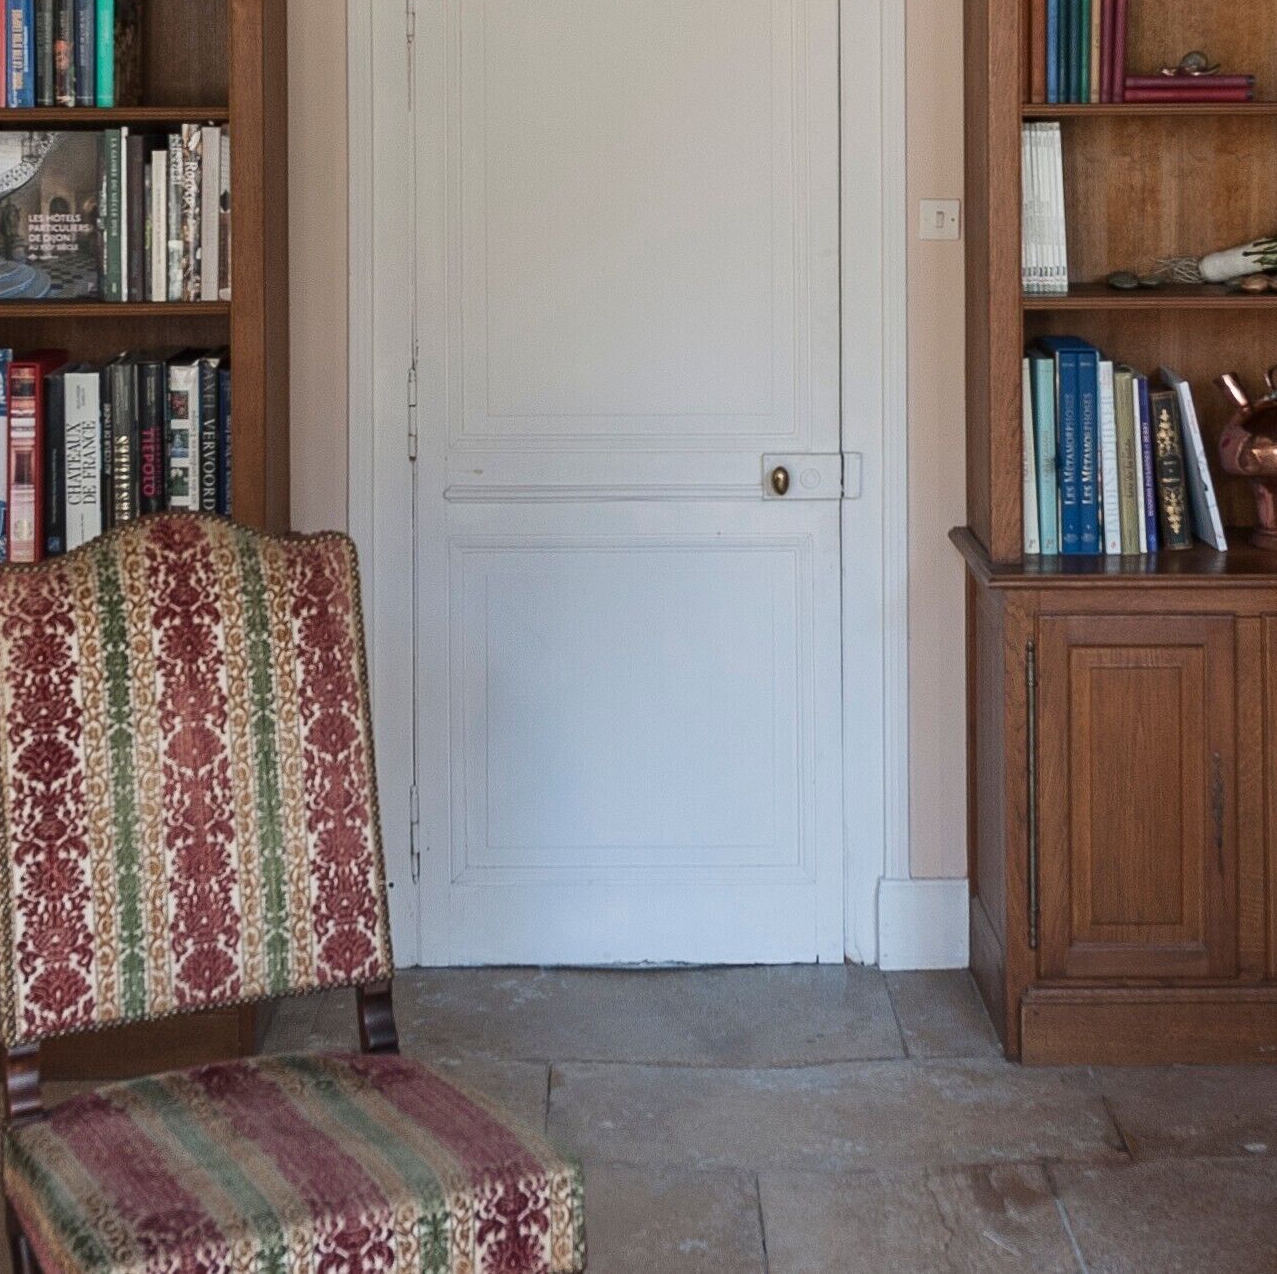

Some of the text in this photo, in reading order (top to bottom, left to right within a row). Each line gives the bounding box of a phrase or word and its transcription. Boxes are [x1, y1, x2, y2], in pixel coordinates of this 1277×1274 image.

[28, 214, 45, 223] LES
[28, 224, 91, 232] PARTICULIERS
[28, 234, 40, 243] DE
[66, 422, 82, 506] CHATEAUX
[82, 420, 96, 504] DE FRANCE
[114, 435, 130, 521] ERSAILLES
[142, 427, 155, 497] TIEPOLO
[203, 369, 216, 511] AXEL VERVOORD
